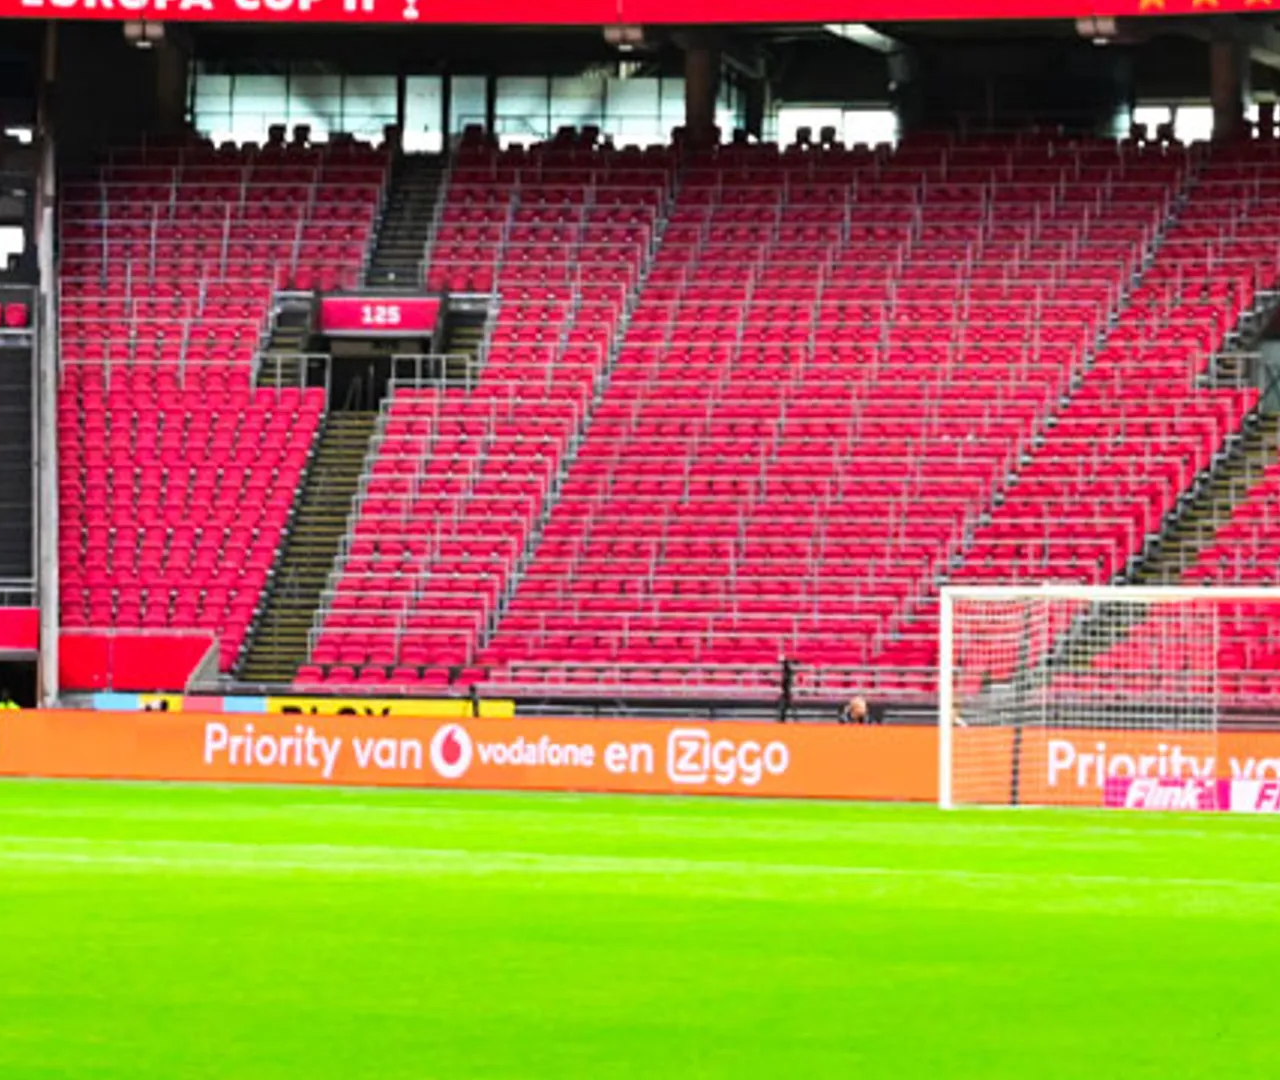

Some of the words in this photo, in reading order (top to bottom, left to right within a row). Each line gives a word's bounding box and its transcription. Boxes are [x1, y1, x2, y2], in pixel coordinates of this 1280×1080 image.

[362, 305, 401, 325] 125
[203, 721, 343, 780] Priority
[351, 738, 423, 770] van
[476, 735, 596, 768] vodafone
[603, 742, 655, 774] en
[665, 727, 790, 787] Ziggo
[1125, 780, 1202, 809] Flink
